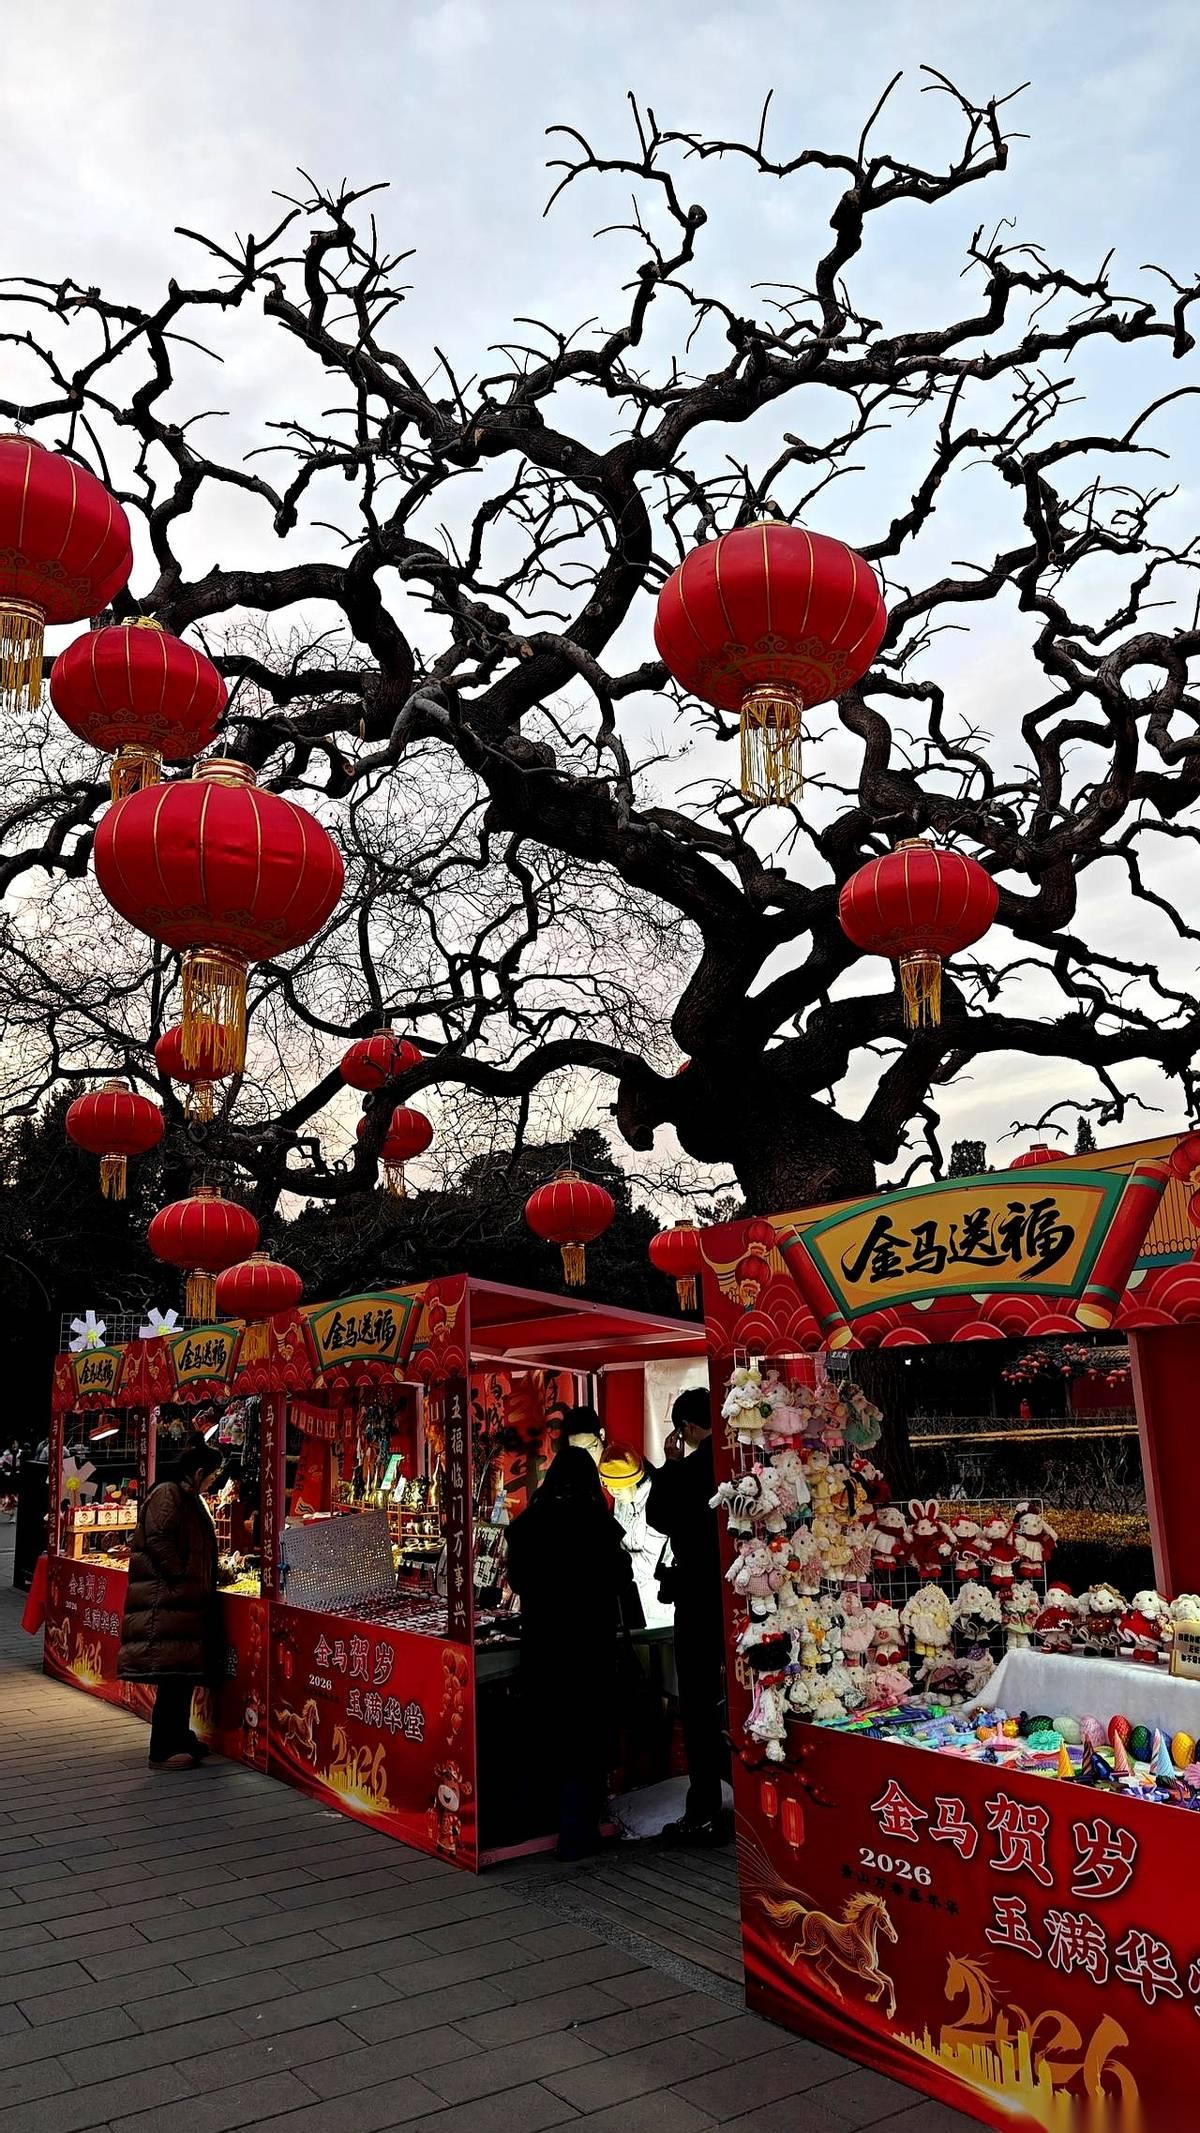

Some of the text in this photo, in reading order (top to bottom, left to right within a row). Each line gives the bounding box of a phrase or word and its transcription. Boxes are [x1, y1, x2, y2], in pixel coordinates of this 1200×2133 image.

[841, 1196, 1075, 1284] 金马送福
[324, 1309, 397, 1349] 金马送福
[80, 1359, 113, 1386] 金马送福
[179, 1339, 226, 1372] 金马送福
[264, 1404, 274, 1588] 马年大吉财运旺
[451, 1394, 466, 1629] 五福临门万事兴
[309, 1674, 332, 1690] 2026
[314, 1634, 394, 1684] 金马贺岁
[346, 1689, 425, 1742] 玉满华堂
[871, 1779, 1137, 1898] 金马贺岁
[858, 1847, 932, 1887] 2026
[985, 1895, 1200, 2018] 玉满华
